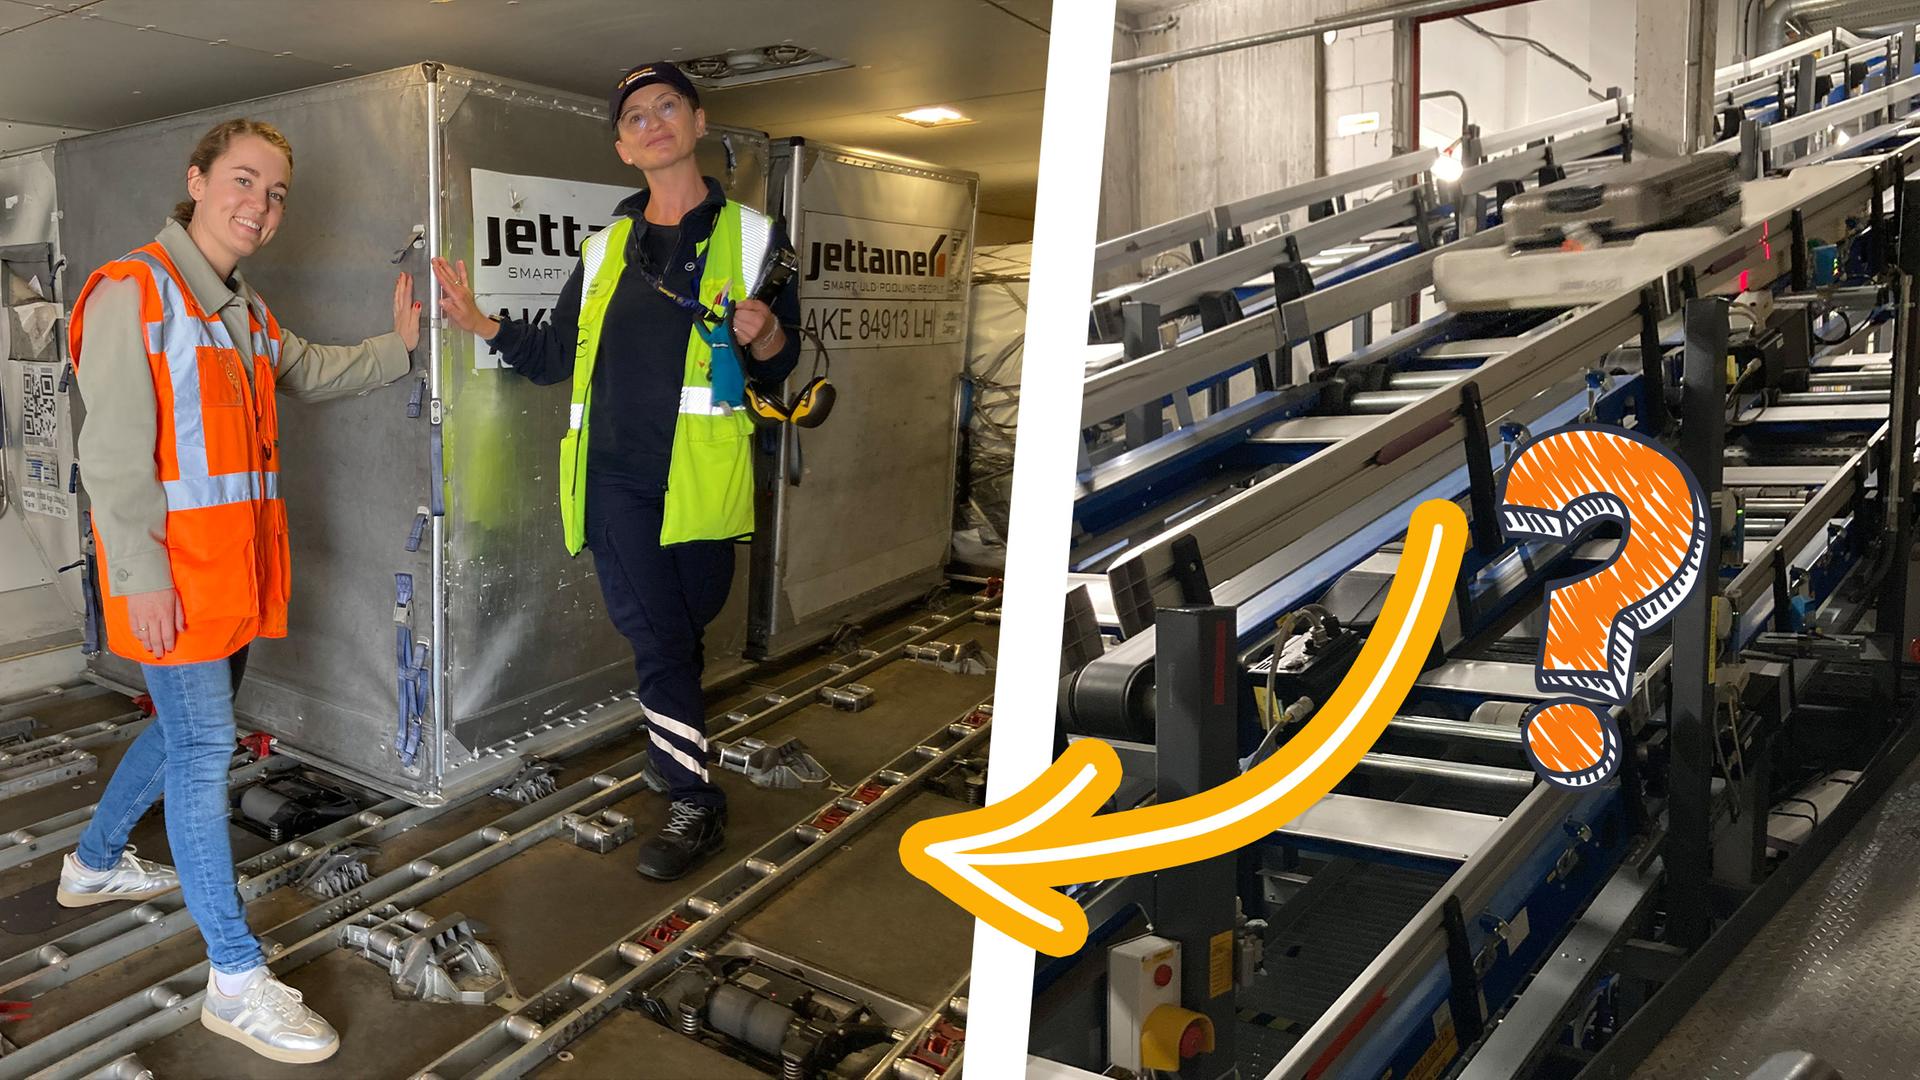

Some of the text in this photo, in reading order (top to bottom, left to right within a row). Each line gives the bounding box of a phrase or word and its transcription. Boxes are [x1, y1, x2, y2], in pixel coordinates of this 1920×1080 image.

[802, 308, 852, 342] AKE
[859, 308, 909, 340] 84913
[914, 308, 933, 338] LH
